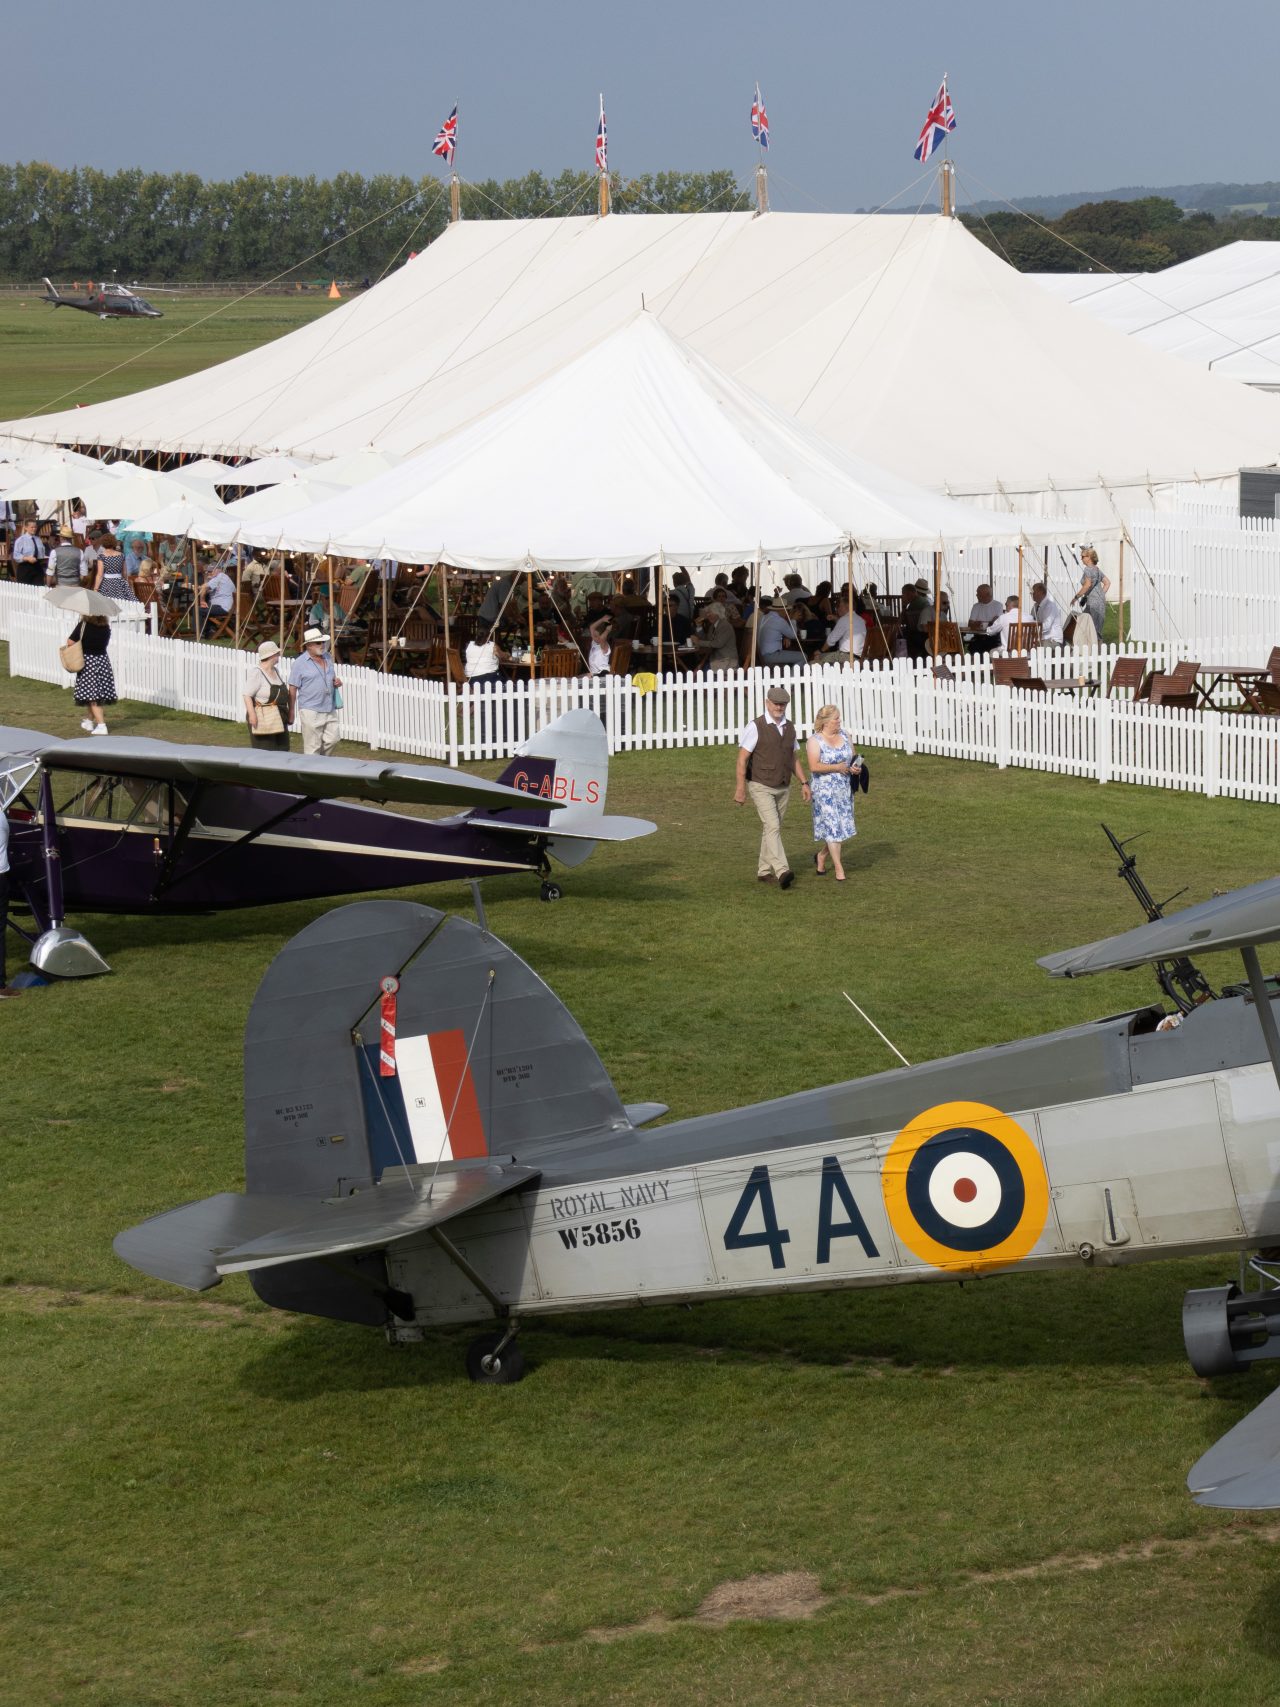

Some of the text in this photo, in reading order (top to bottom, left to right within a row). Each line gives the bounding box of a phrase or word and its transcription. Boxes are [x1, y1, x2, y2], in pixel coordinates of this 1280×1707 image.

[514, 771, 599, 803] G-ABLS
[550, 1179, 670, 1219] ROYAL NAVY
[558, 1218, 641, 1250] W5856
